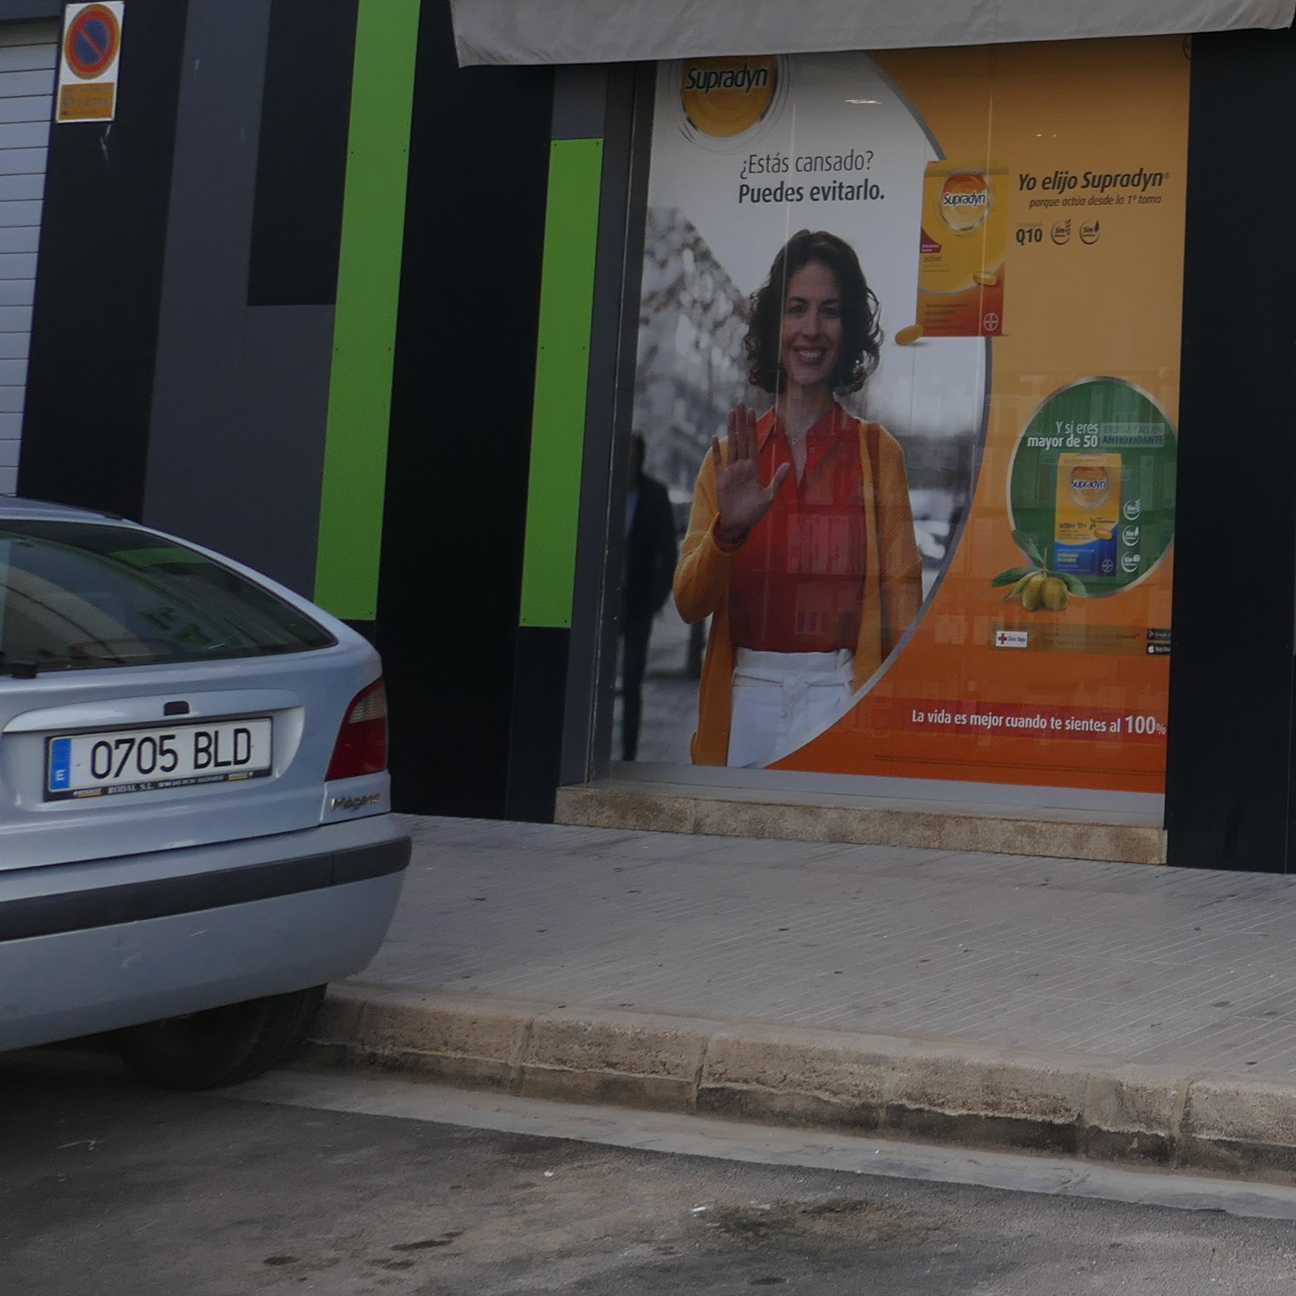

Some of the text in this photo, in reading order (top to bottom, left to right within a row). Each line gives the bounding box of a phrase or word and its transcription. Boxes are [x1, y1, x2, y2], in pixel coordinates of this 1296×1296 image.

[685, 63, 769, 94] Supradyn
[739, 149, 874, 180] ¿Estás cansado?
[1018, 167, 1165, 194] Yo elijo Supradyn
[738, 178, 885, 204] Puedes evitarlo.
[943, 192, 986, 207] Supradyn
[1028, 197, 1059, 209] porque
[1061, 196, 1086, 207] actúa
[1088, 194, 1113, 206] desde
[1115, 194, 1125, 205] la
[1138, 195, 1162, 204] toma
[1016, 228, 1043, 246] Q10
[1056, 421, 1099, 435] Y si eres
[1027, 434, 1098, 450] mayor de 50
[1071, 479, 1106, 491] Supradyn
[912, 709, 924, 723] La
[927, 710, 951, 724] vida
[954, 713, 967, 725] es
[970, 712, 1003, 729] mejor
[1005, 715, 1047, 729] cuando
[1050, 716, 1062, 730] te
[1064, 716, 1107, 732] sientes
[1109, 718, 1121, 733] al
[90, 727, 252, 780] 0705 BLD
[55, 769, 65, 782] E
